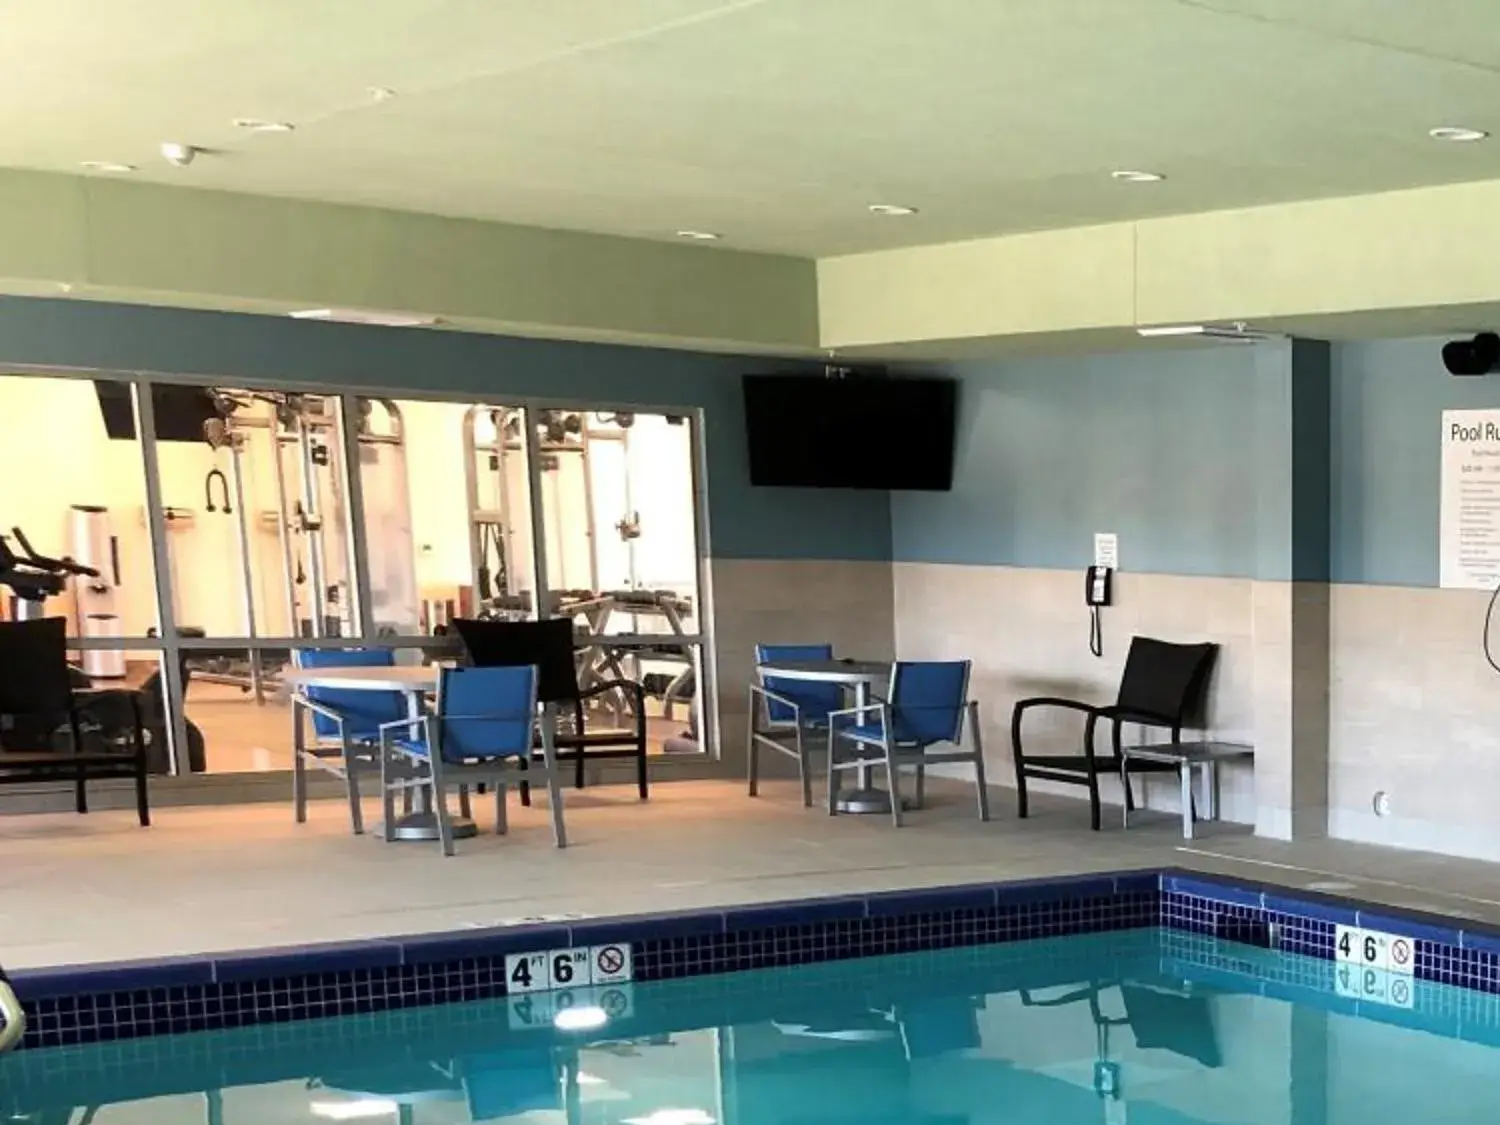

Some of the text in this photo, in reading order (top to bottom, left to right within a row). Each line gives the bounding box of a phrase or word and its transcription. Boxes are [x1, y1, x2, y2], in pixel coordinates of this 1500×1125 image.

[1451, 421, 1482, 441] Pool
[1339, 932, 1377, 963] 4 6
[511, 957, 532, 987] 4
[553, 954, 573, 983] 6
[573, 952, 587, 962] IN
